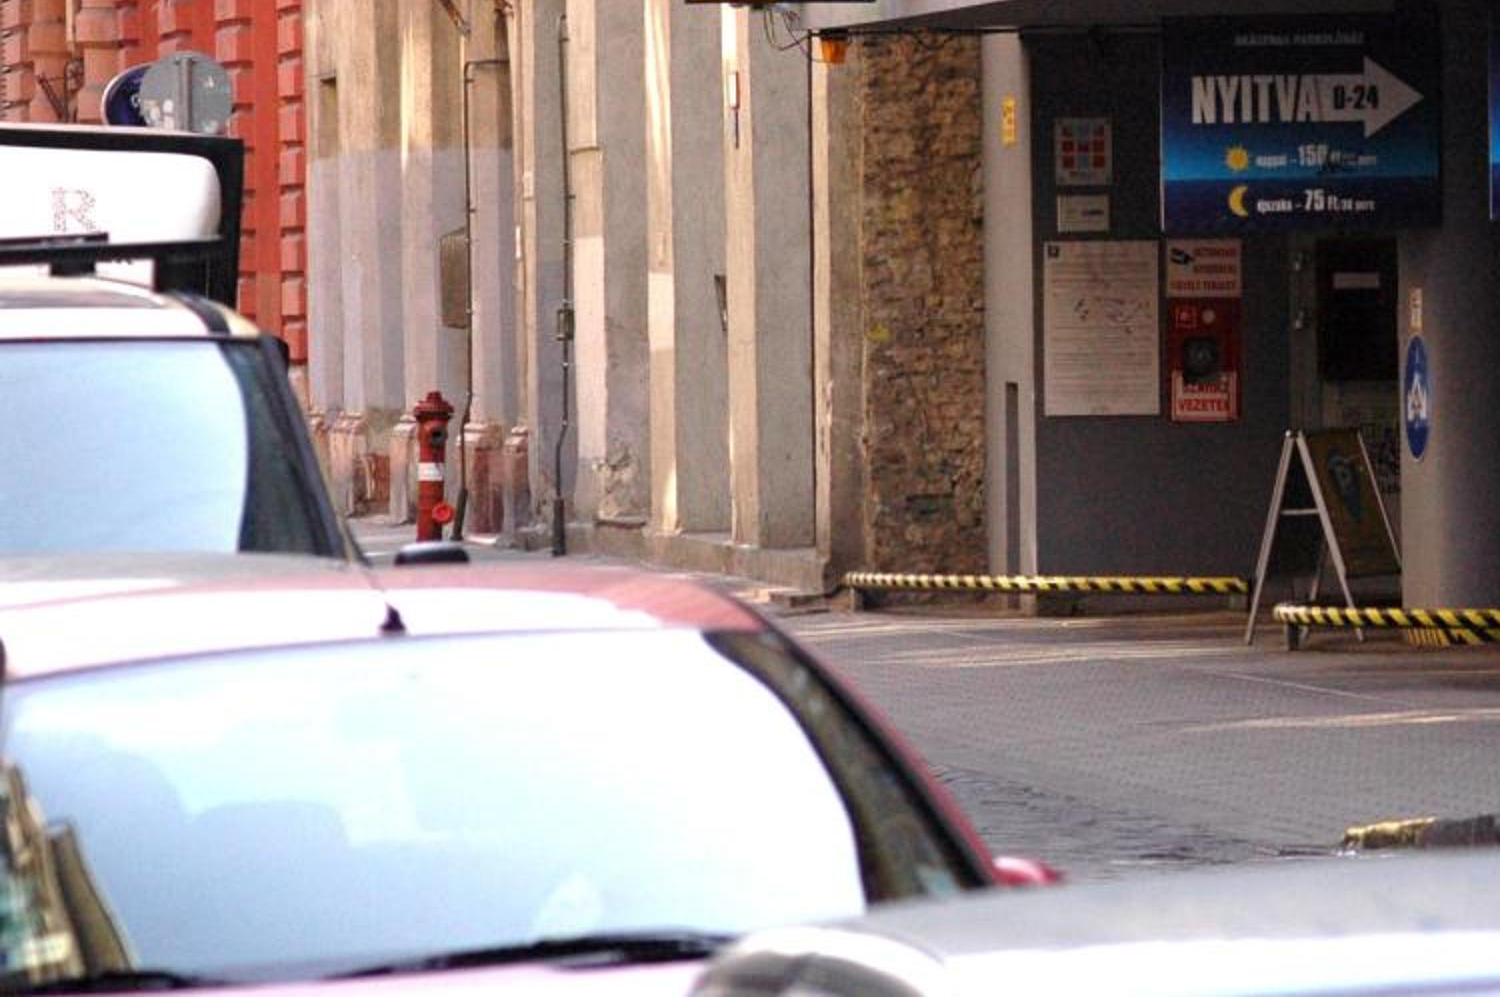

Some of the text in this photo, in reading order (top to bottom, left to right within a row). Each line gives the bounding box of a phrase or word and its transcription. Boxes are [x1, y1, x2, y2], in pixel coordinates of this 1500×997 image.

[1190, 74, 1380, 124] NYITVA 0-24
[1297, 143, 1329, 167] 150
[1304, 187, 1325, 212] 75
